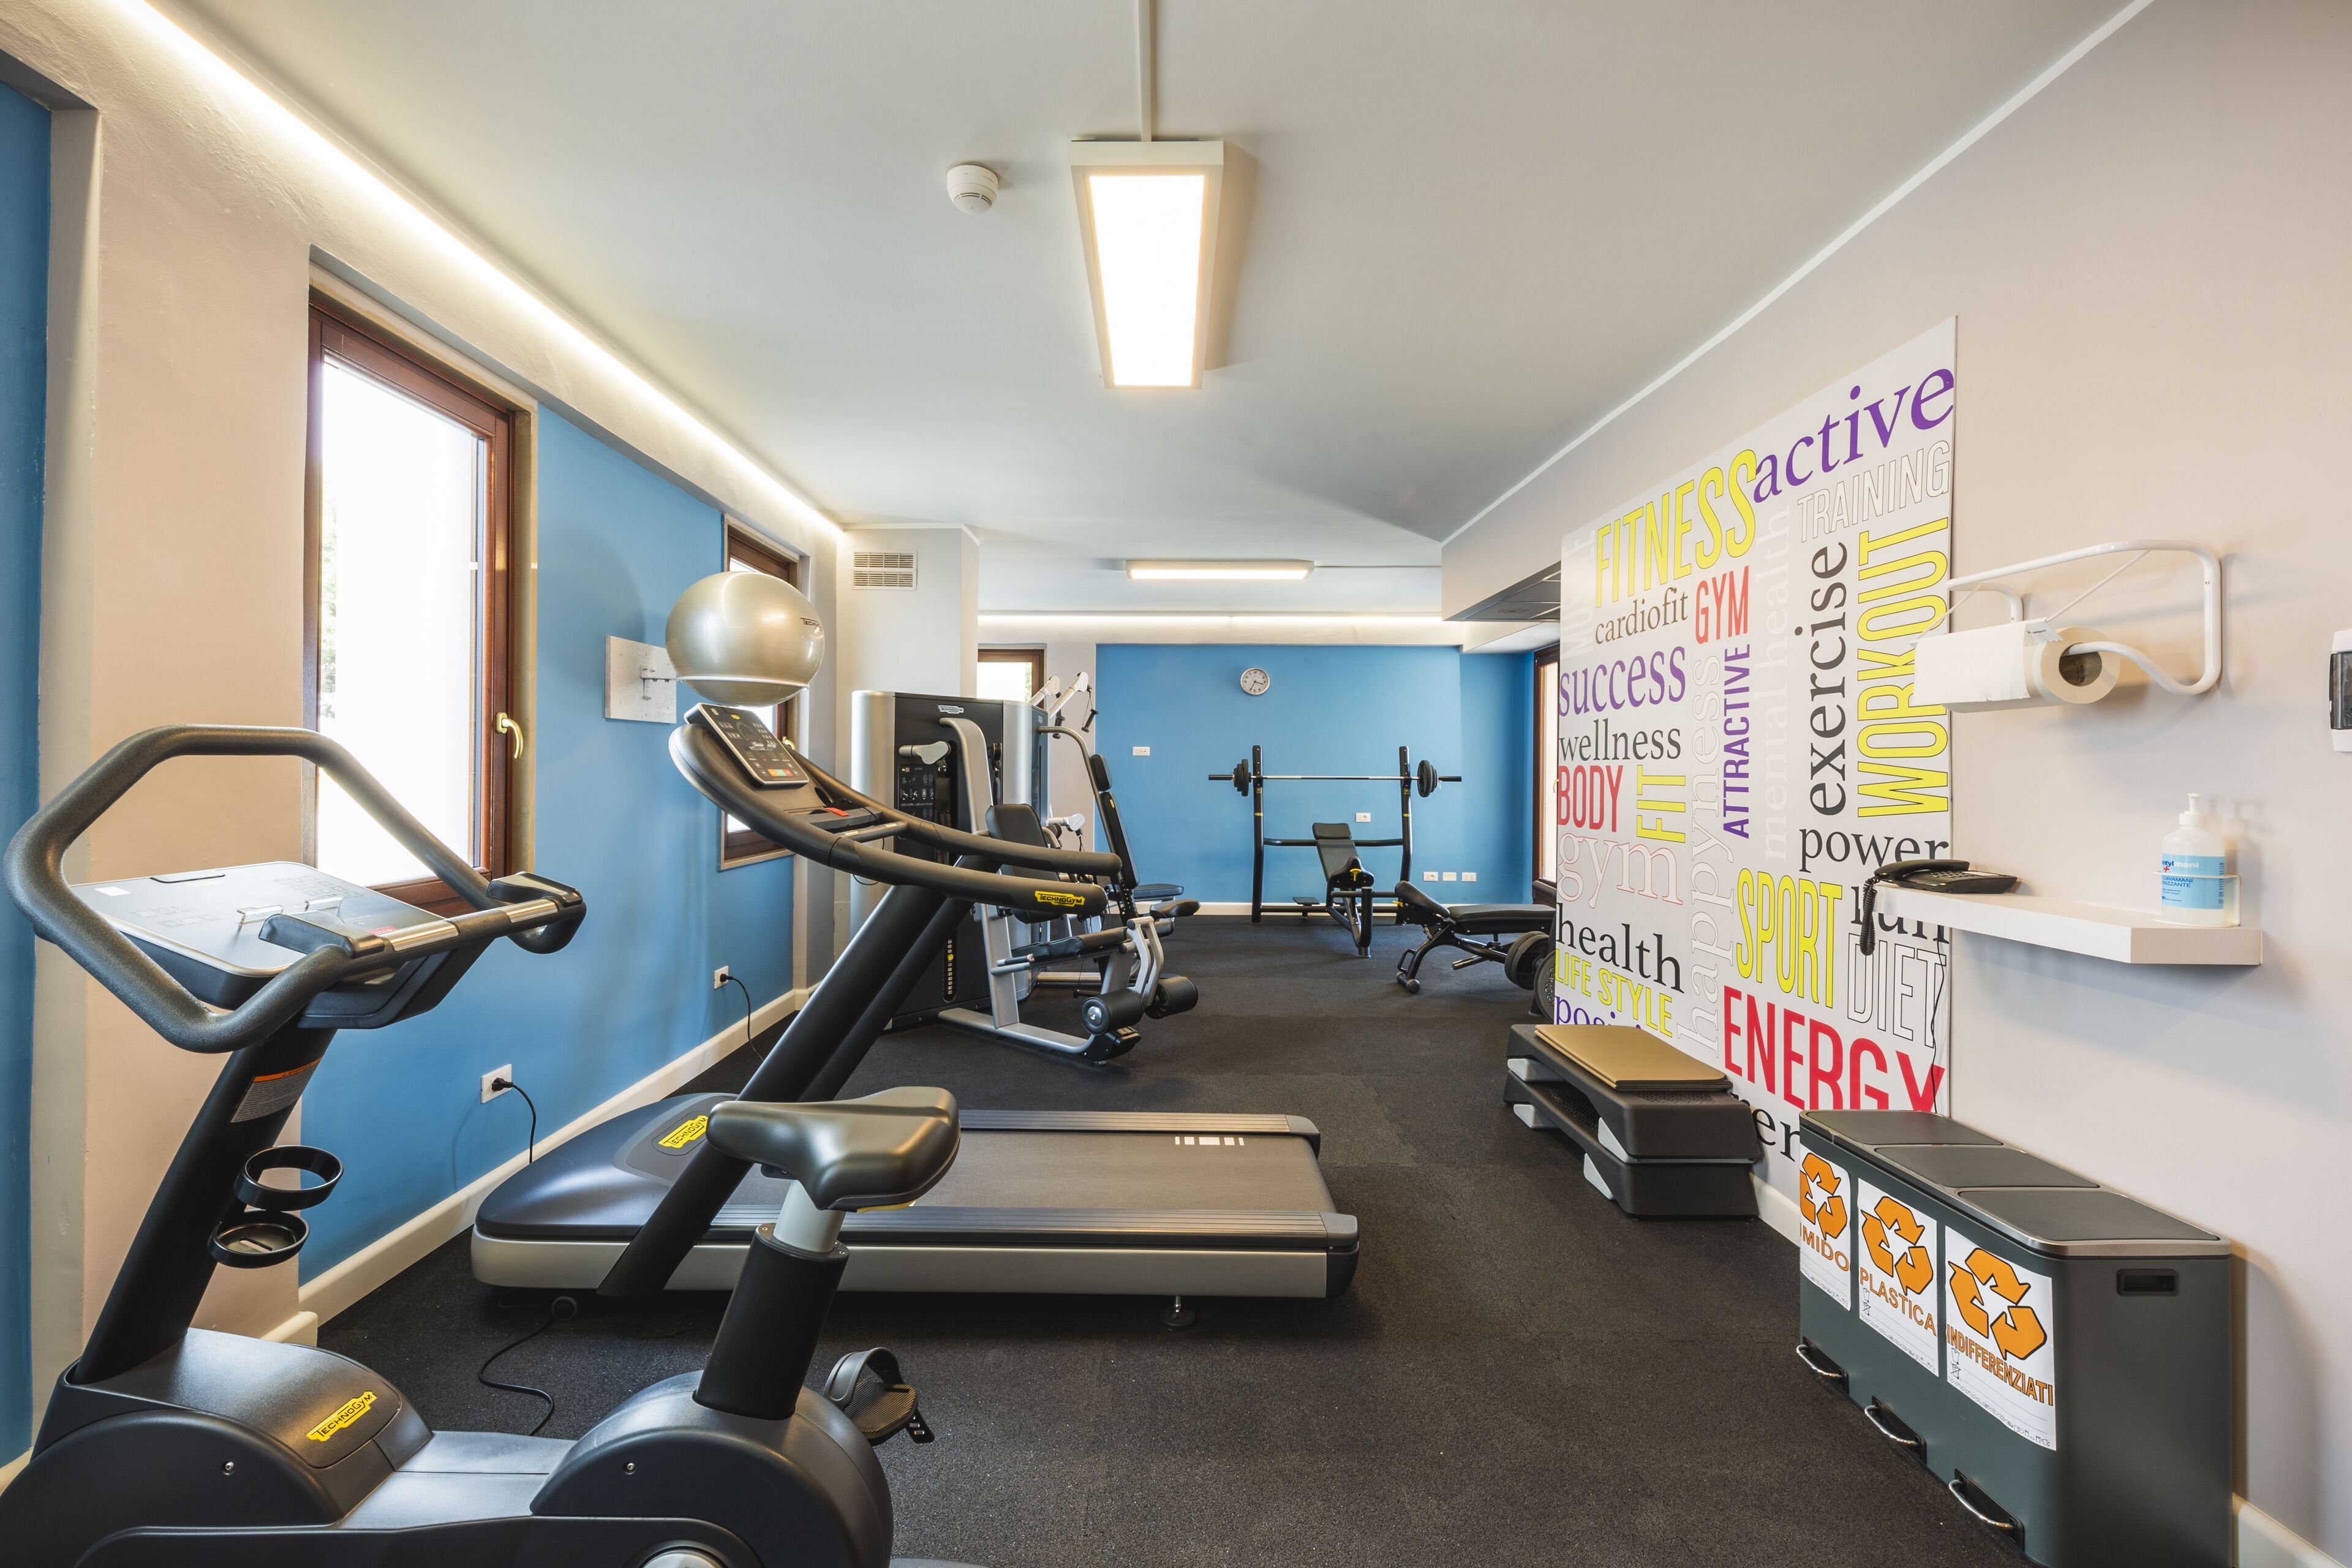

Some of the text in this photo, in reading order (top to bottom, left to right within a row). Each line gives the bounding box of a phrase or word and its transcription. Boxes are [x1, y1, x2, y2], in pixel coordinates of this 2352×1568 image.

[1754, 369, 1954, 503] active
[1595, 450, 1757, 608] FITNESS
[1797, 440, 1950, 543] TRAINING
[1595, 587, 1688, 644] cardiofit
[1695, 565, 1749, 644] GYM
[1559, 646, 1686, 717] success
[1795, 542, 1847, 815] exercise
[1857, 517, 1948, 818] WORKOUT
[1559, 718, 1681, 761] wellness
[1723, 644, 1750, 839] ATTRACTIVE
[1558, 765, 1624, 832] BODY
[1637, 765, 1686, 843] FIT
[1557, 833, 1683, 909] gym
[1678, 655, 1734, 1058] happyness
[1800, 826, 1949, 873] power
[1556, 903, 1684, 994] health
[1736, 868, 1842, 1009] SPORT
[1555, 948, 1591, 997] LIFE
[1597, 968, 1673, 1038] STYLE
[1847, 933, 1947, 1049] DIET
[1724, 985, 1945, 1112] ENERGY
[1800, 1223, 1849, 1272] MIDO
[1860, 1267, 1937, 1337] PLASTICA
[1947, 1324, 2053, 1407] INDIFFERENZIATI
